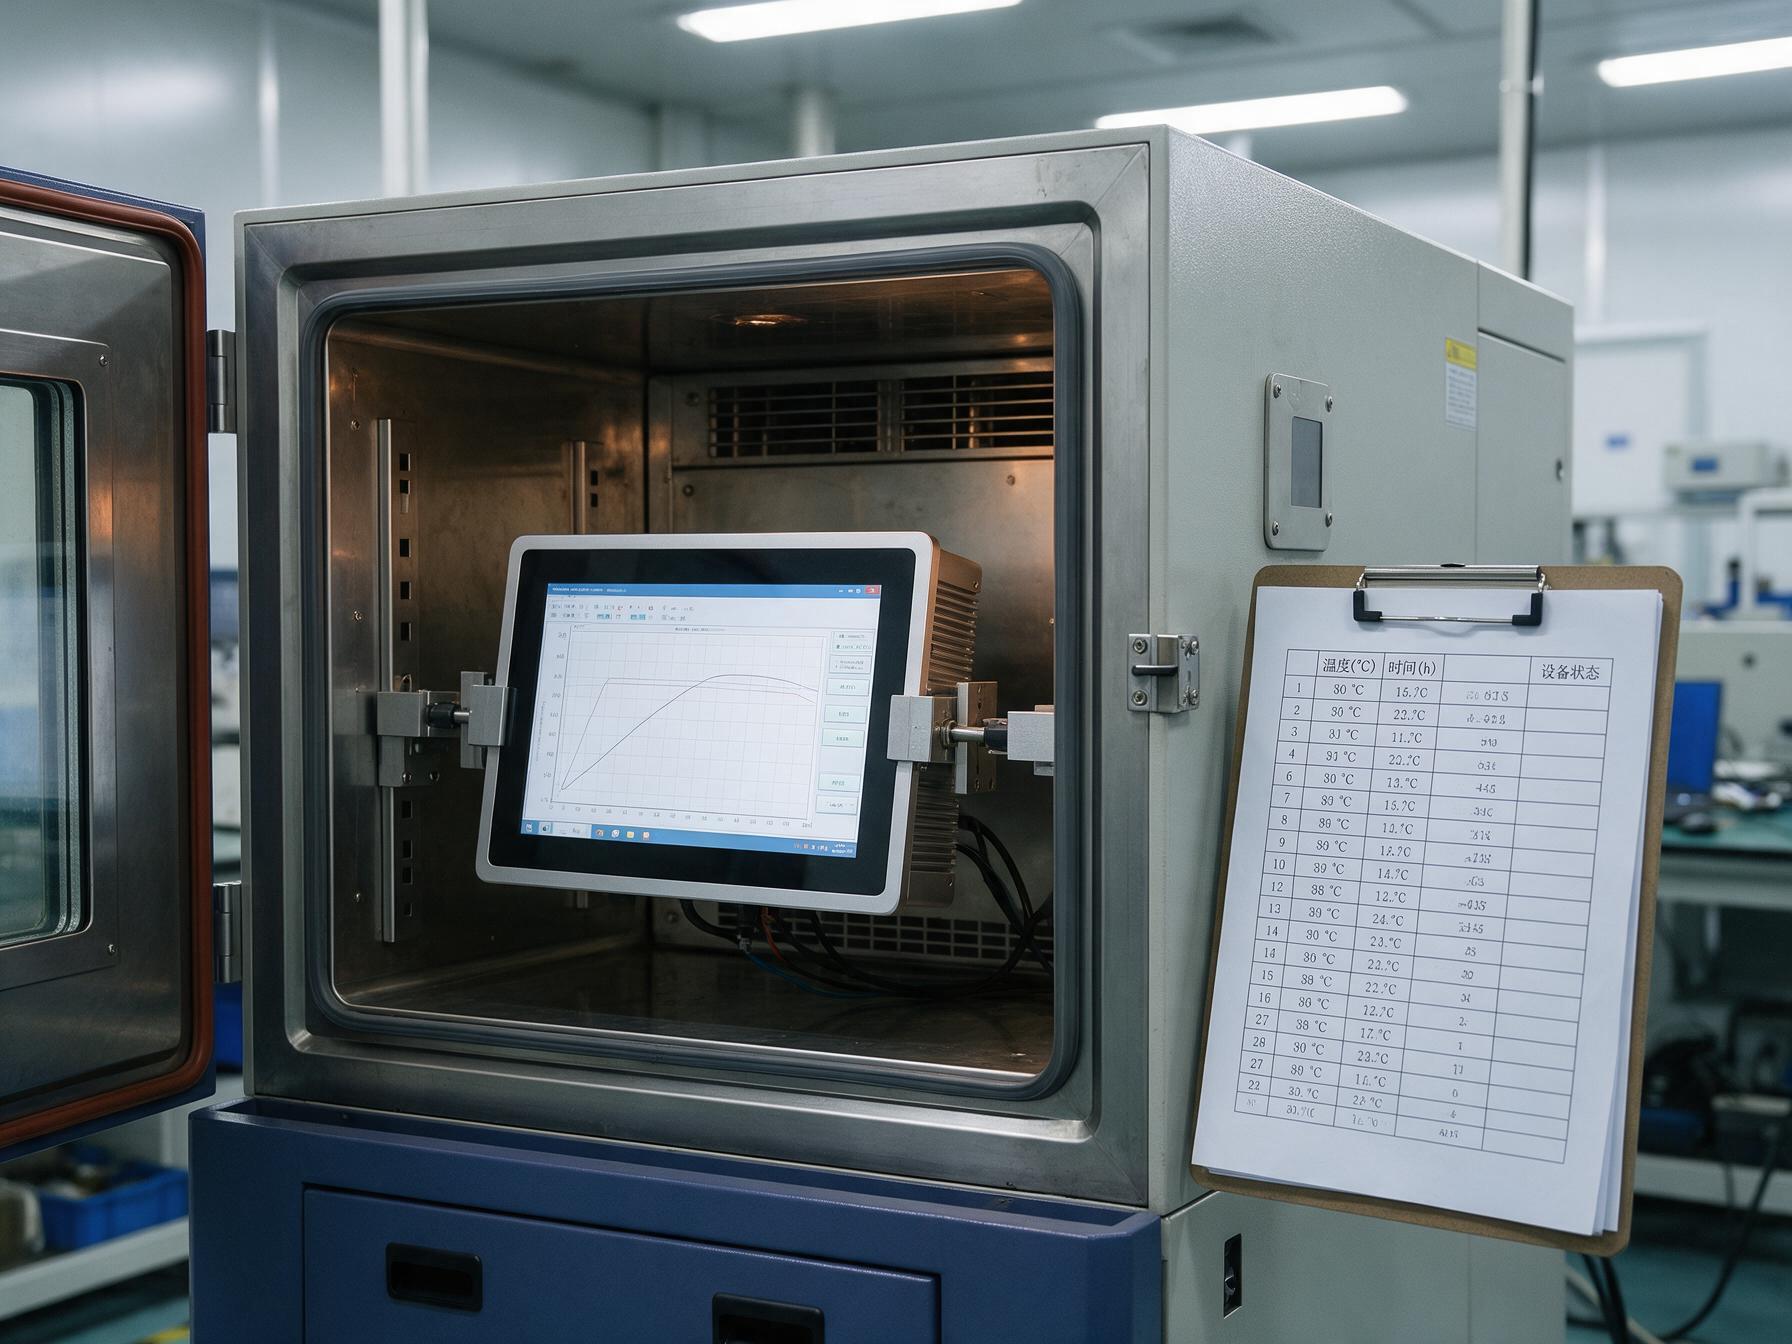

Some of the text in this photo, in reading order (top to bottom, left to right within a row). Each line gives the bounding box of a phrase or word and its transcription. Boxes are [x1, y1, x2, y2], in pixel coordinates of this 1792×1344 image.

[1323, 658, 1600, 681] 温度(°C) 时间(h) 设备状态
[1297, 682, 1301, 693] 1
[1294, 705, 1300, 715] 2
[1291, 726, 1298, 737] 3
[1288, 749, 1295, 759] 4
[1286, 770, 1293, 781] 6
[1284, 792, 1291, 804] 7
[1281, 814, 1288, 825] 8
[1279, 837, 1286, 847] 9
[1273, 859, 1286, 870] 10
[1271, 882, 1284, 892] 12
[1269, 903, 1281, 914] 13
[1266, 925, 1278, 936] 14
[1262, 969, 1274, 981] 15
[1259, 992, 1271, 1003] 16
[1255, 1013, 1269, 1026] 27
[1250, 1058, 1264, 1070] 27
